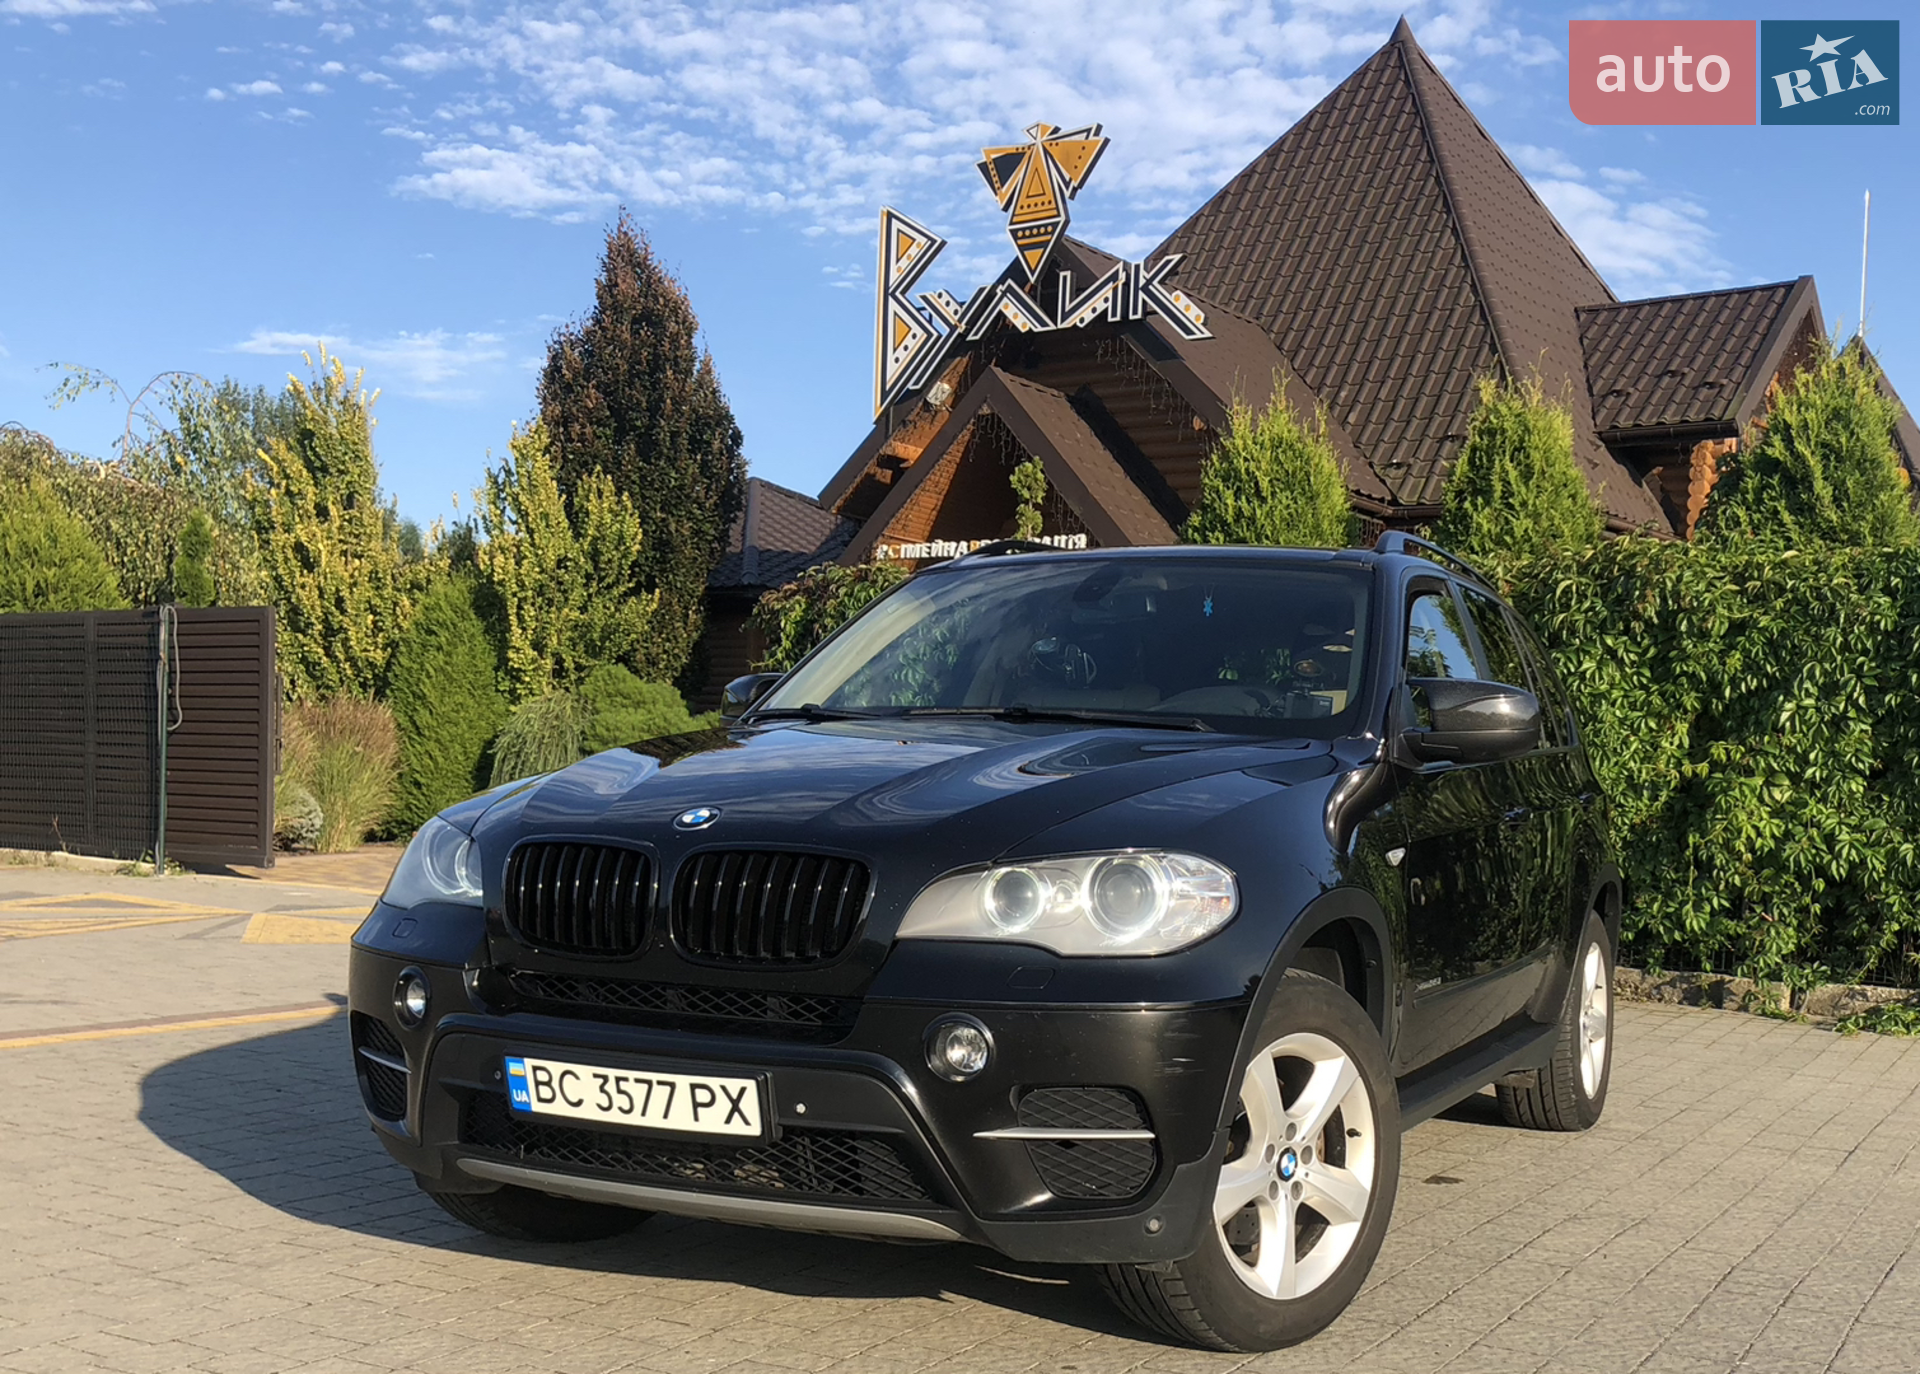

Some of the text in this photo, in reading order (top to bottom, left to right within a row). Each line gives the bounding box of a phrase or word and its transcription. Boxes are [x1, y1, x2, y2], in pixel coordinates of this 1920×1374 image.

[512, 1088, 530, 1104] UA
[531, 1064, 752, 1127] BC 3577 PX
